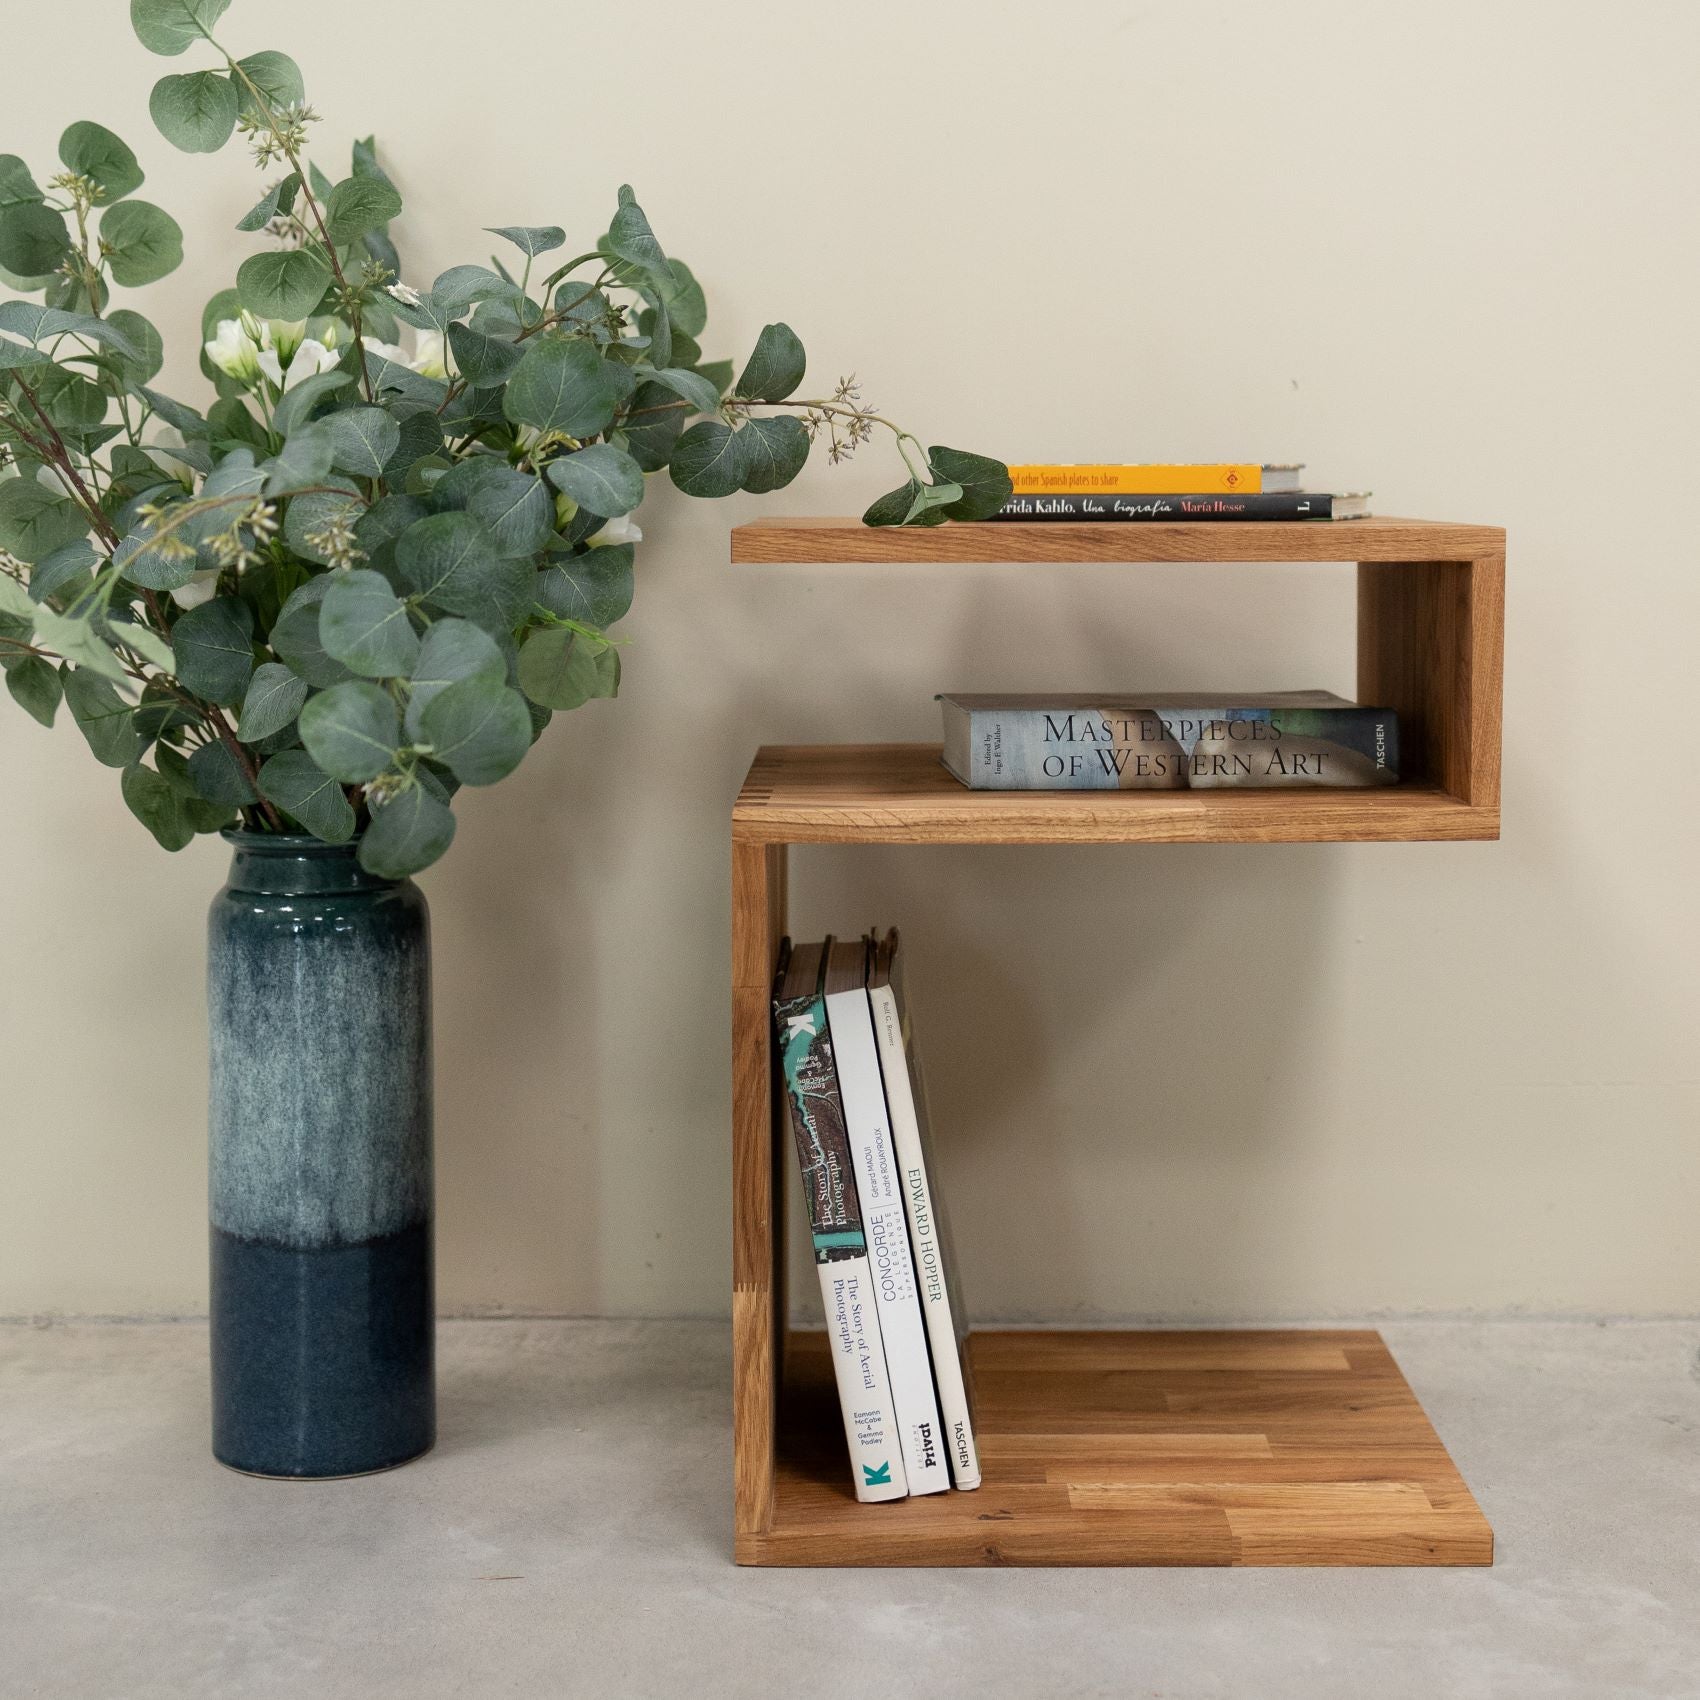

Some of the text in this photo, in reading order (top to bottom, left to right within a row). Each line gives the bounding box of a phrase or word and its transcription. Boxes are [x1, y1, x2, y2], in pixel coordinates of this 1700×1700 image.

[1021, 472, 1039, 487] other
[1041, 472, 1067, 489] Spanish
[1069, 472, 1089, 488] plates
[1091, 474, 1098, 487] to
[1100, 472, 1119, 487] share
[1036, 499, 1076, 514] Kahlo.
[1083, 498, 1105, 513] Una
[1114, 499, 1173, 518] biografía
[1181, 499, 1212, 513] María
[1214, 500, 1245, 513] Hesse
[984, 733, 993, 742] by
[1043, 714, 1283, 742] MASTERPIECES
[1043, 747, 1329, 778] OF WESTERN ART
[1376, 724, 1386, 770] TASCHEN
[787, 1013, 817, 1041] K
[817, 1169, 829, 1202] Story
[827, 1150, 847, 1226] Photography
[882, 1175, 892, 1197] André
[908, 1168, 942, 1303] EDWARD HOPPER
[871, 1215, 896, 1301] CONCORDE
[833, 1279, 854, 1355] Photography
[847, 1275, 876, 1390] The Story of Aerial
[918, 1422, 937, 1468] Privat
[954, 1420, 970, 1468] TASCHEN
[862, 1460, 892, 1487] K
